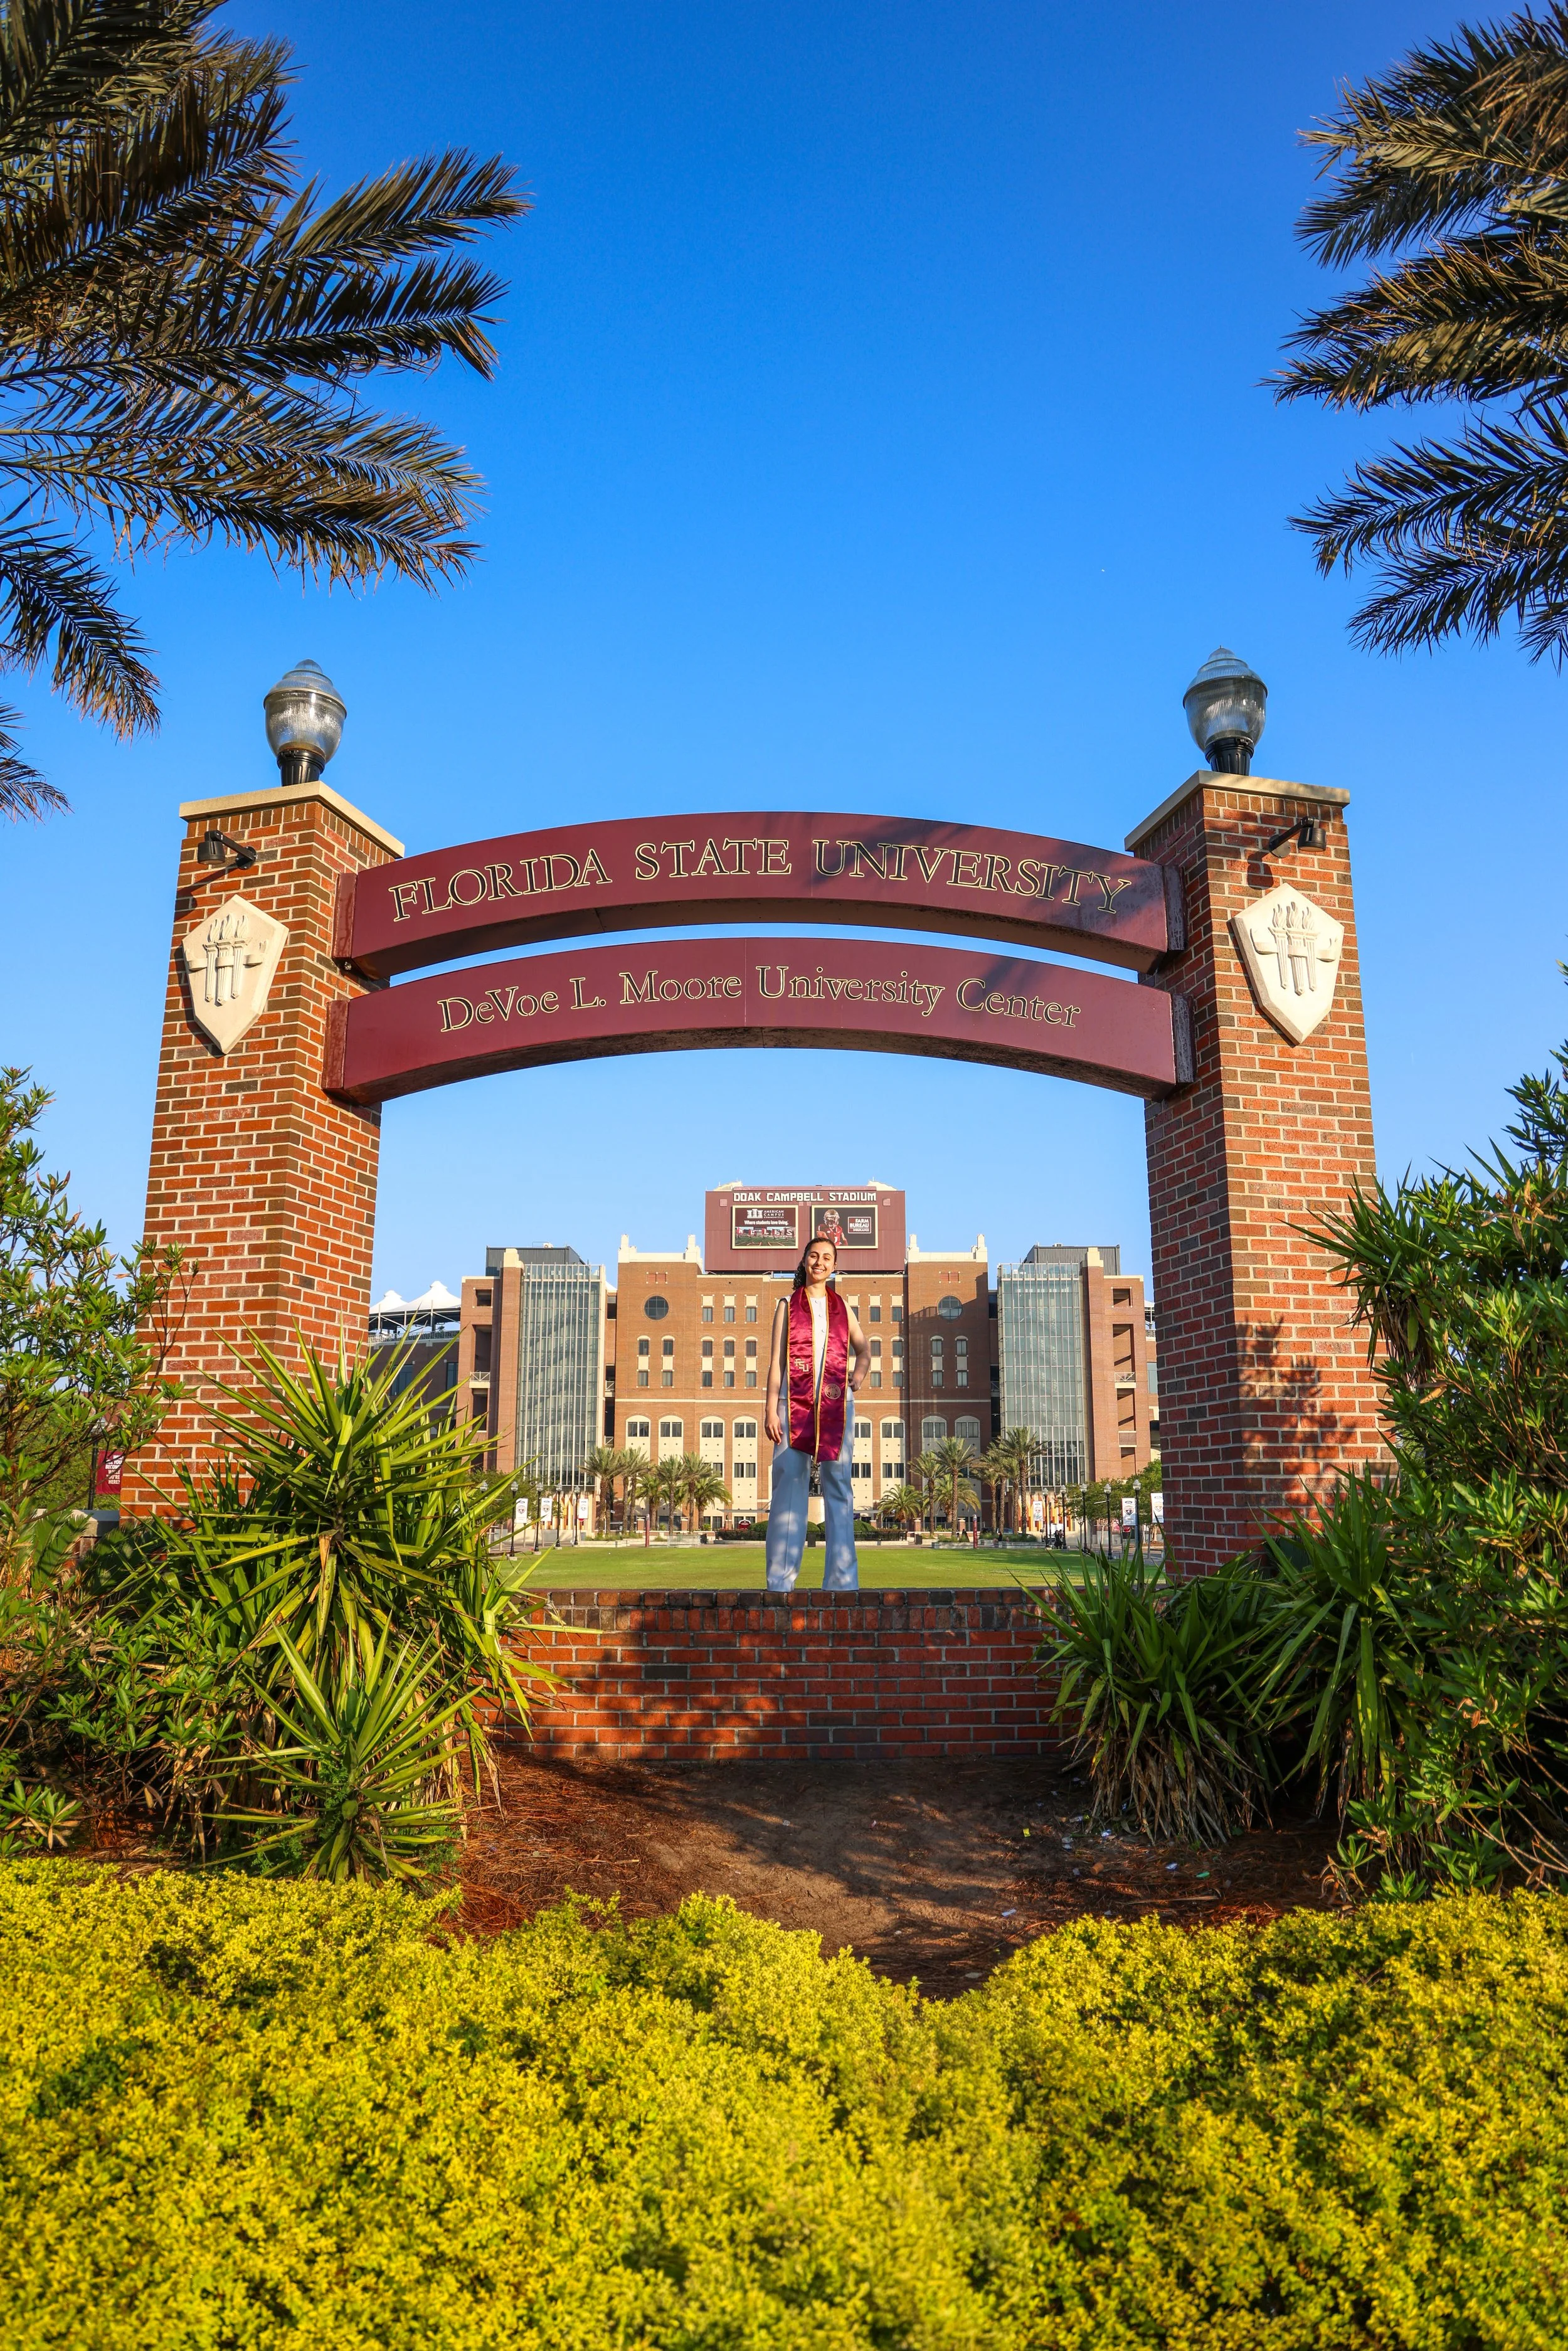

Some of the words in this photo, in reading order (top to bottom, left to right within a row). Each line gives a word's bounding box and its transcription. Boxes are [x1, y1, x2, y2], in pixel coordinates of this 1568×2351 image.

[388, 848, 613, 922] FLORIDA
[635, 838, 792, 879] STATE
[813, 839, 1131, 914] UNIVERSITY
[437, 985, 559, 1032] DeVoe
[569, 977, 607, 1009] L.
[618, 970, 743, 1004] Moore
[756, 965, 945, 1017] University
[956, 978, 1081, 1028] Center
[733, 1192, 761, 1202] DOAK
[766, 1192, 824, 1202] CAMPBELL
[829, 1192, 877, 1201] STADIUM
[794, 1358, 809, 1372] FSU
